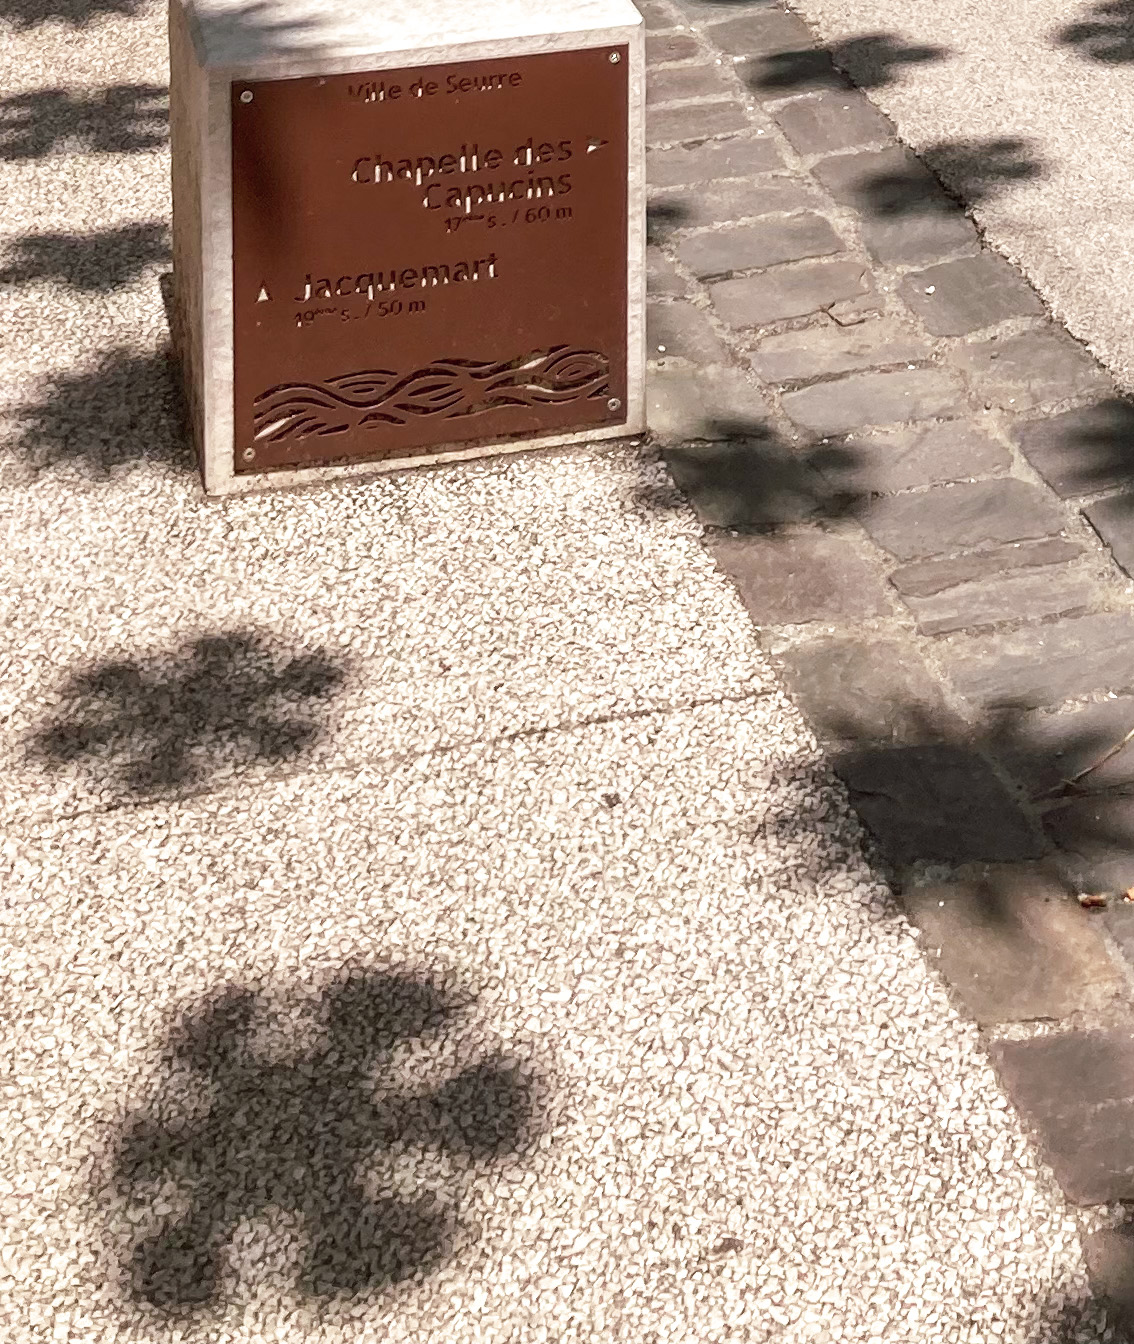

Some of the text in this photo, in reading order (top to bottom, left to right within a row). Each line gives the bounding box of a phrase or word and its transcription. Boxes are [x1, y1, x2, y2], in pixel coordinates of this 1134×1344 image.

[348, 71, 523, 103] Ville de Seurre
[352, 137, 573, 186] Chapelle des
[422, 170, 573, 214] Capucins
[525, 206, 551, 223] 60
[556, 207, 573, 220] m
[294, 253, 499, 303] Jacquemart
[377, 300, 403, 318] 50
[408, 298, 427, 313] m
